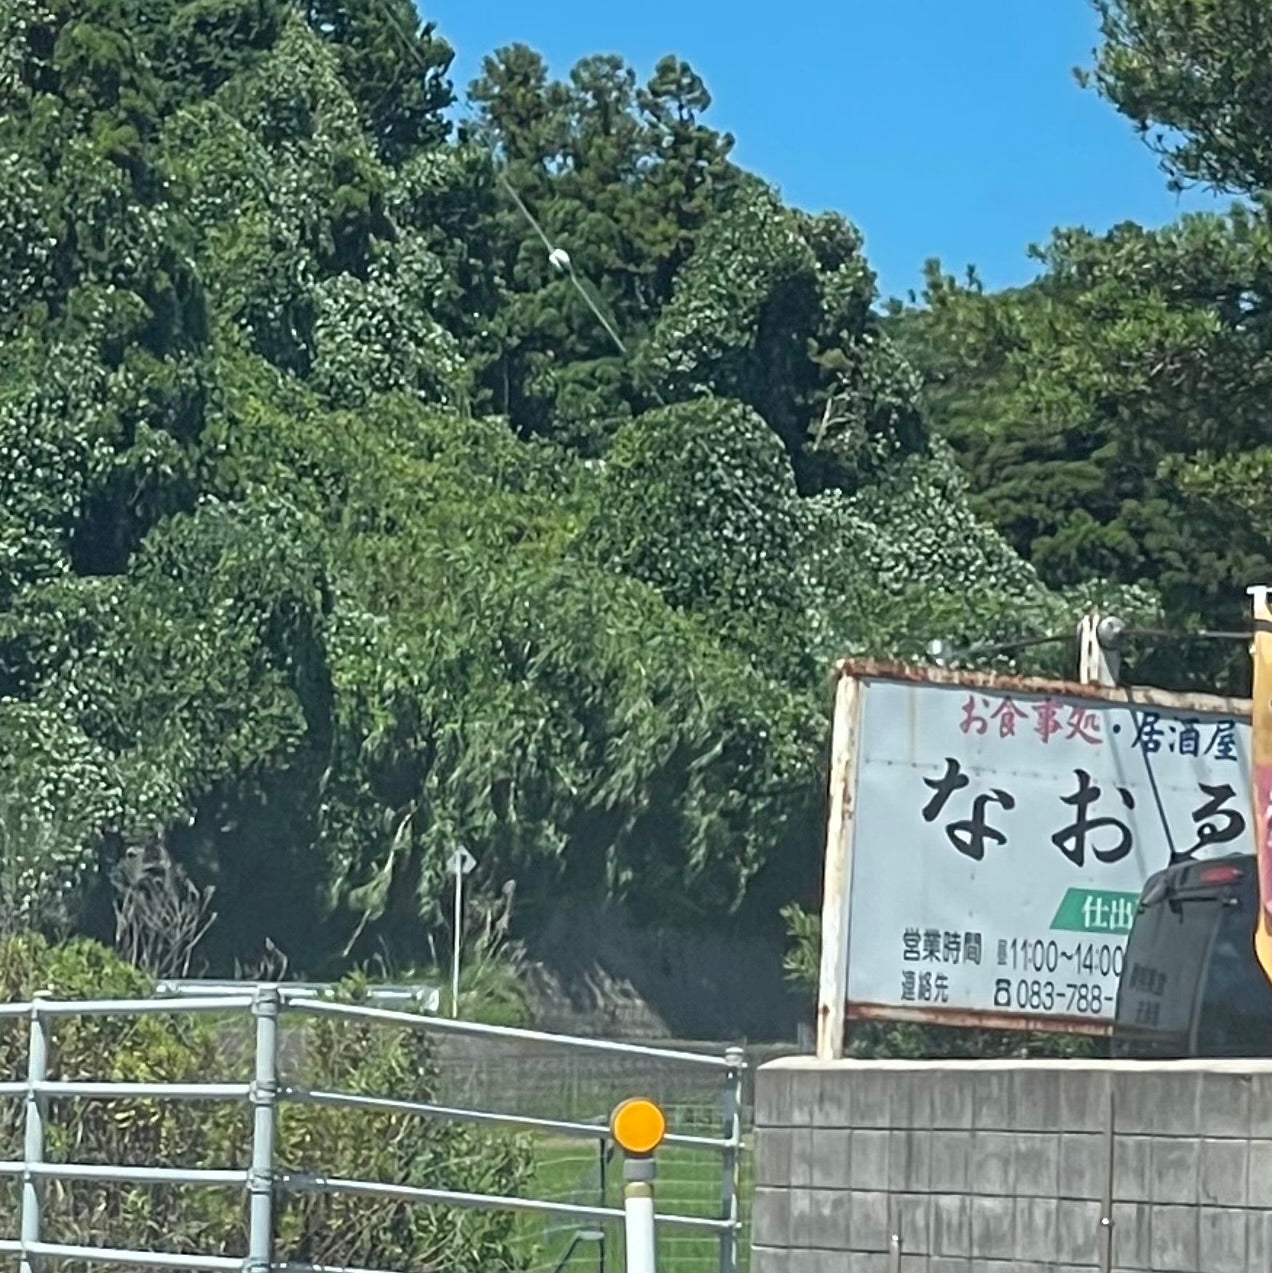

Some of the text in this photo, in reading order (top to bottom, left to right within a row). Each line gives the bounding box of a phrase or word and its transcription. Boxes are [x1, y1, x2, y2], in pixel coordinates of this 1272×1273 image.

[922, 756, 1247, 866] なおる
[1082, 895, 1139, 930] 仕出
[903, 927, 982, 966] 営業時間
[901, 970, 949, 1003] 連絡先
